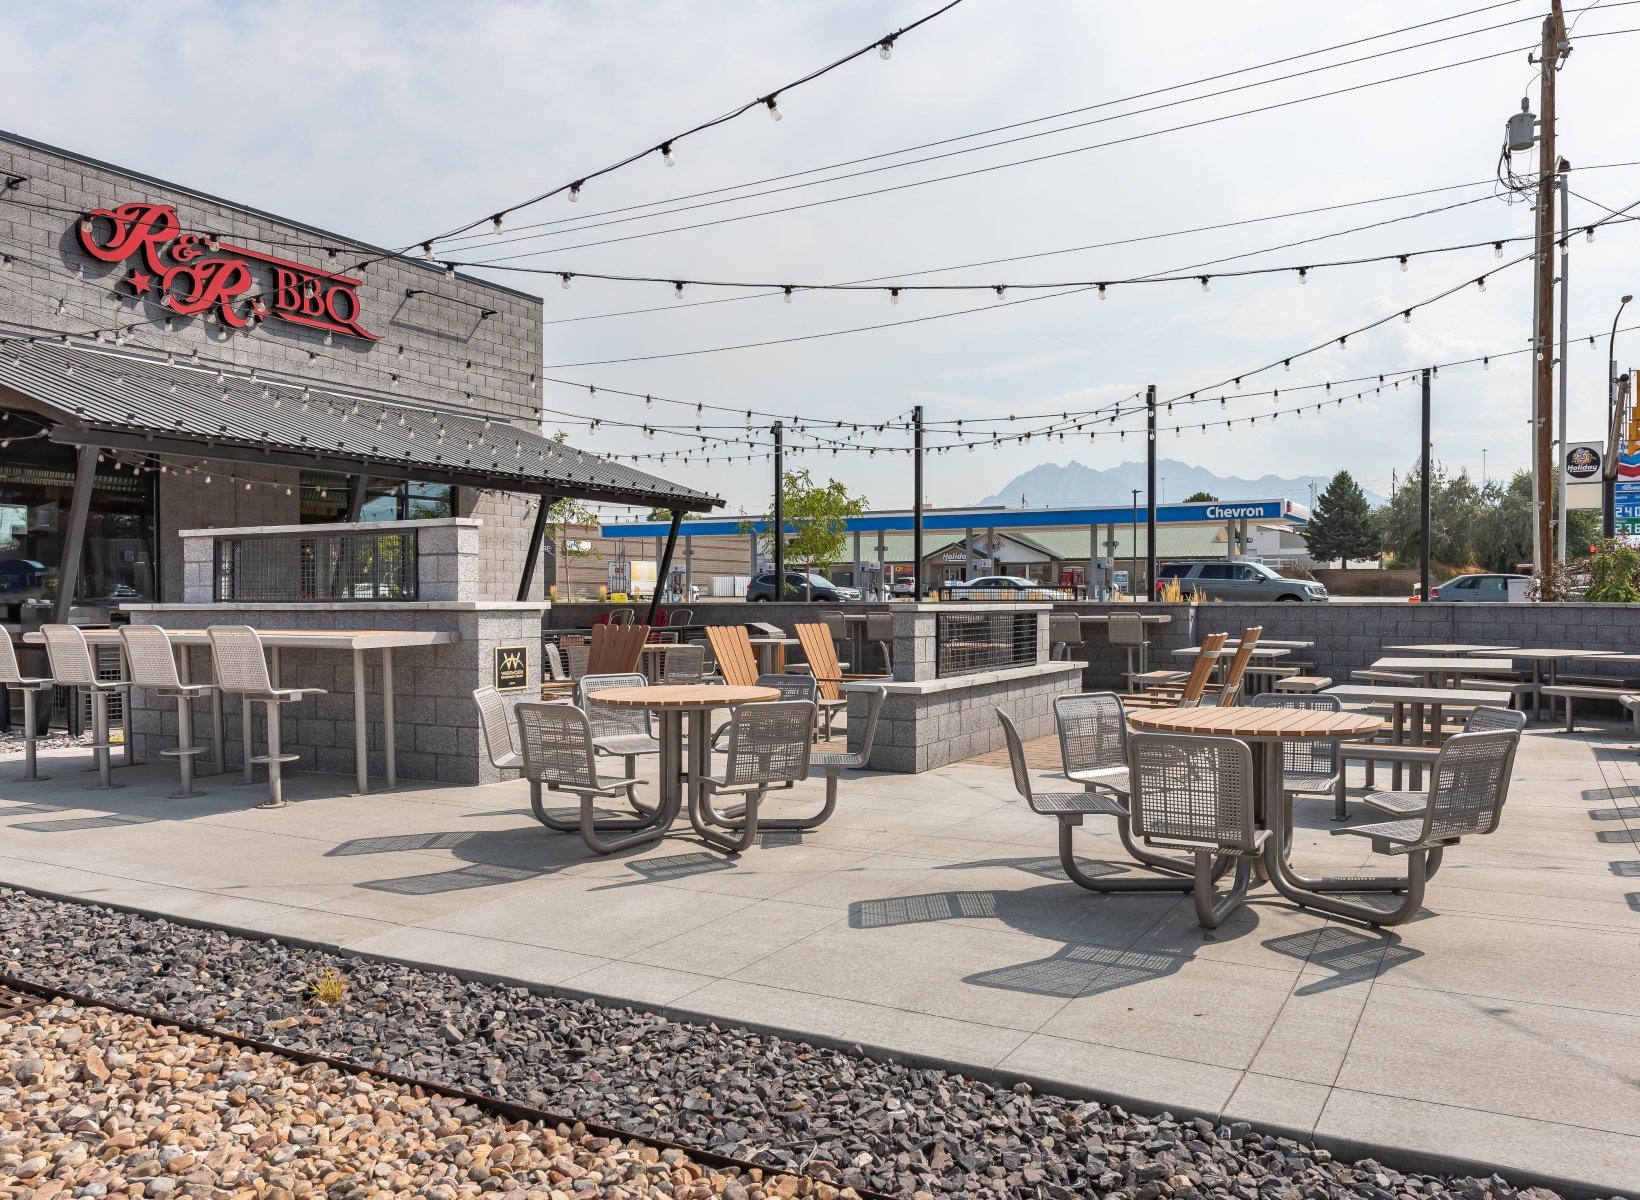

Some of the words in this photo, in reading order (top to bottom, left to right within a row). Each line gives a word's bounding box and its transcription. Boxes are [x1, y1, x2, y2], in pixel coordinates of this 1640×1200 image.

[273, 267, 374, 335] BBQ
[1567, 464, 1598, 473] Holiday
[1206, 506, 1264, 519] Chevron
[942, 552, 967, 562] Holida
